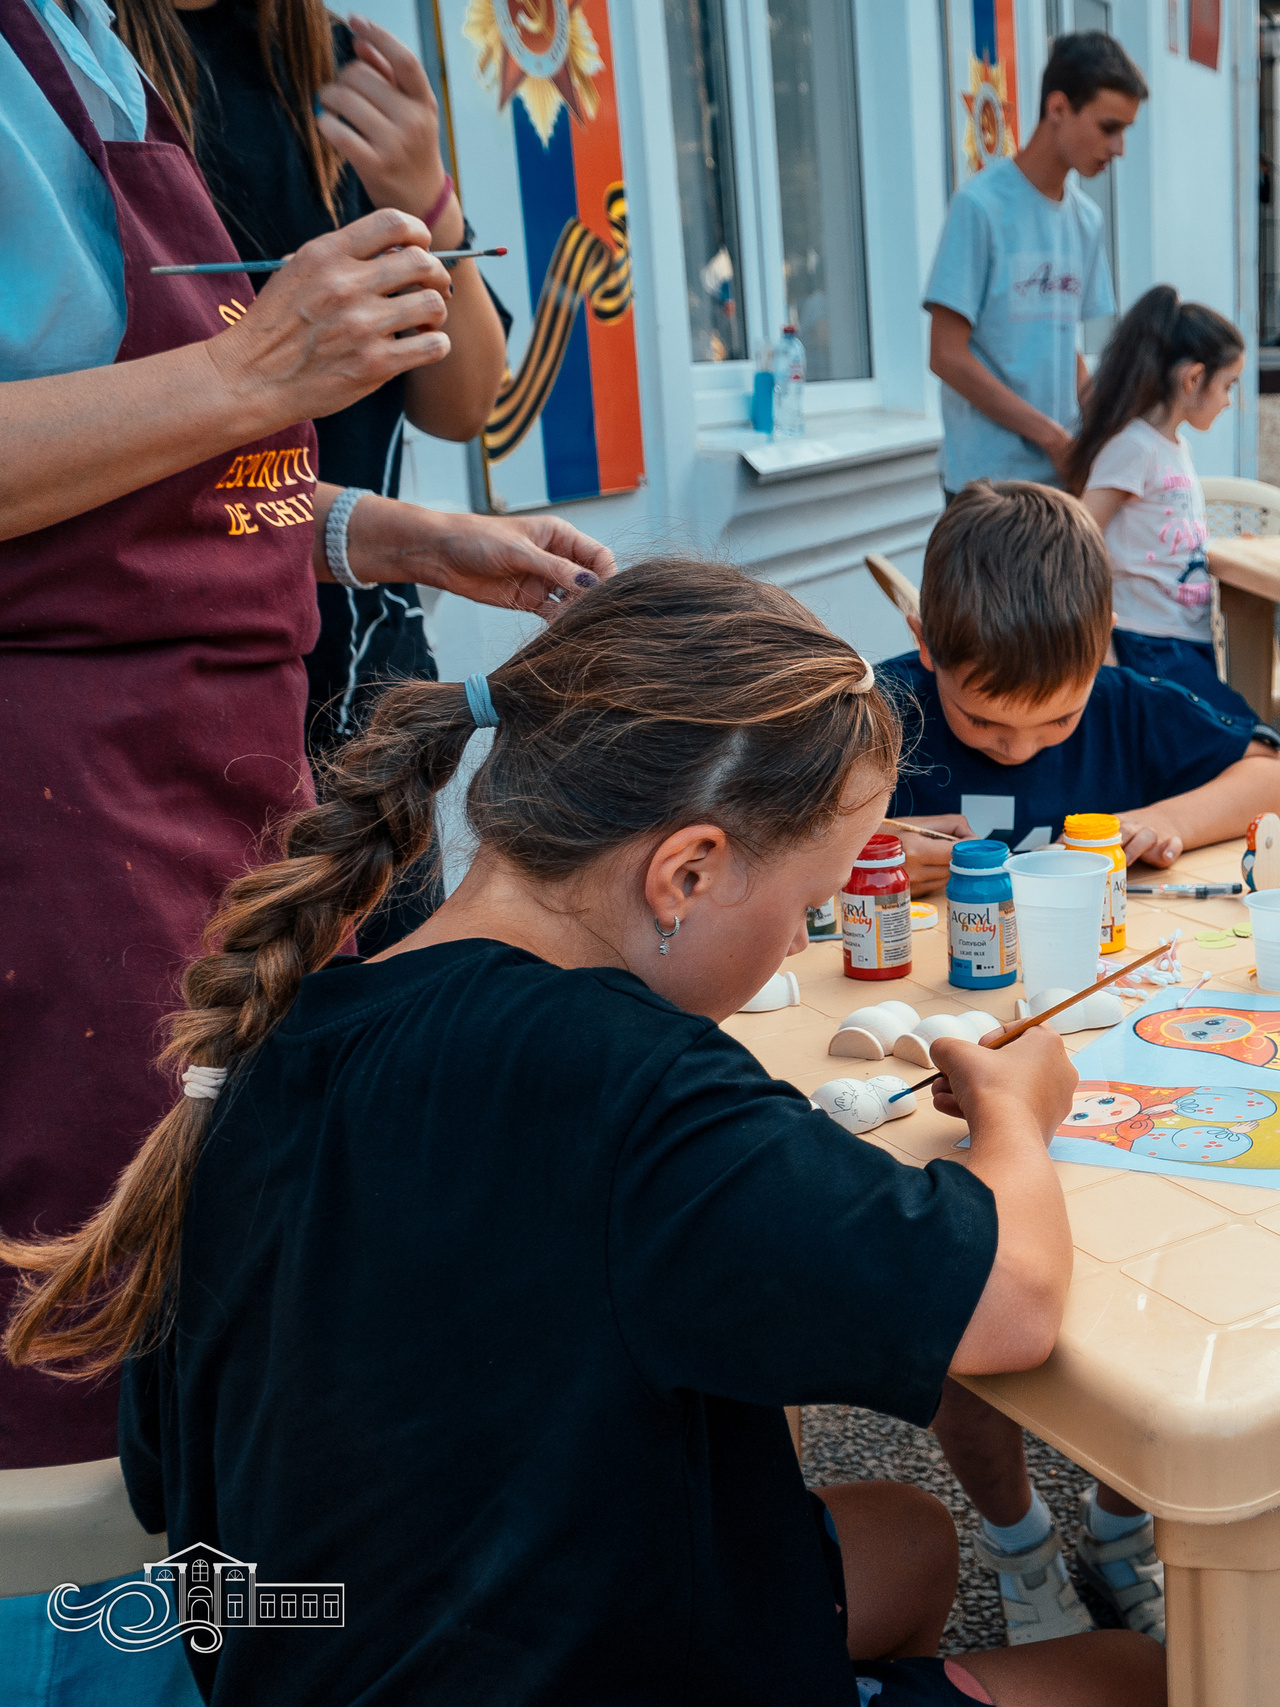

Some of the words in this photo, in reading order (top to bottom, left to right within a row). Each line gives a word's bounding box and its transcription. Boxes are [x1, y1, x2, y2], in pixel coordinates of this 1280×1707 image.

[214, 446, 318, 492] ESPIRITU
[223, 502, 259, 536] DE
[961, 916, 997, 941] hobby
